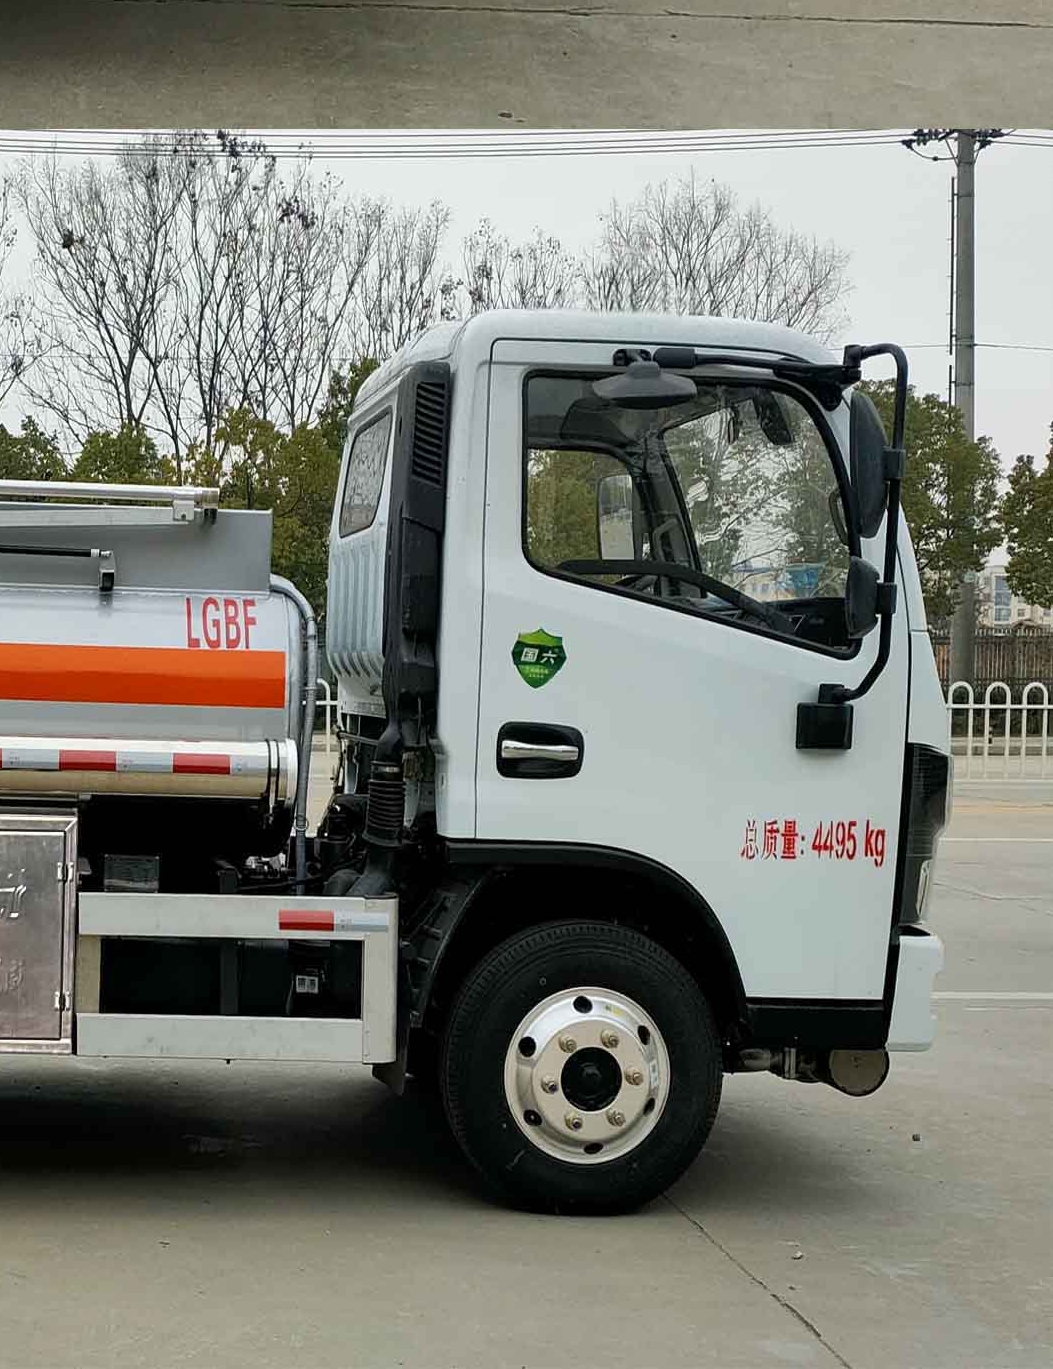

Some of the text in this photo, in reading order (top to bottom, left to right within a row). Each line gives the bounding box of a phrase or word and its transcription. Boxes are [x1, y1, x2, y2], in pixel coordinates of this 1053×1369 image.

[186, 596, 258, 650] LGBF
[811, 820, 858, 861] 4495
[864, 819, 887, 868] kg
